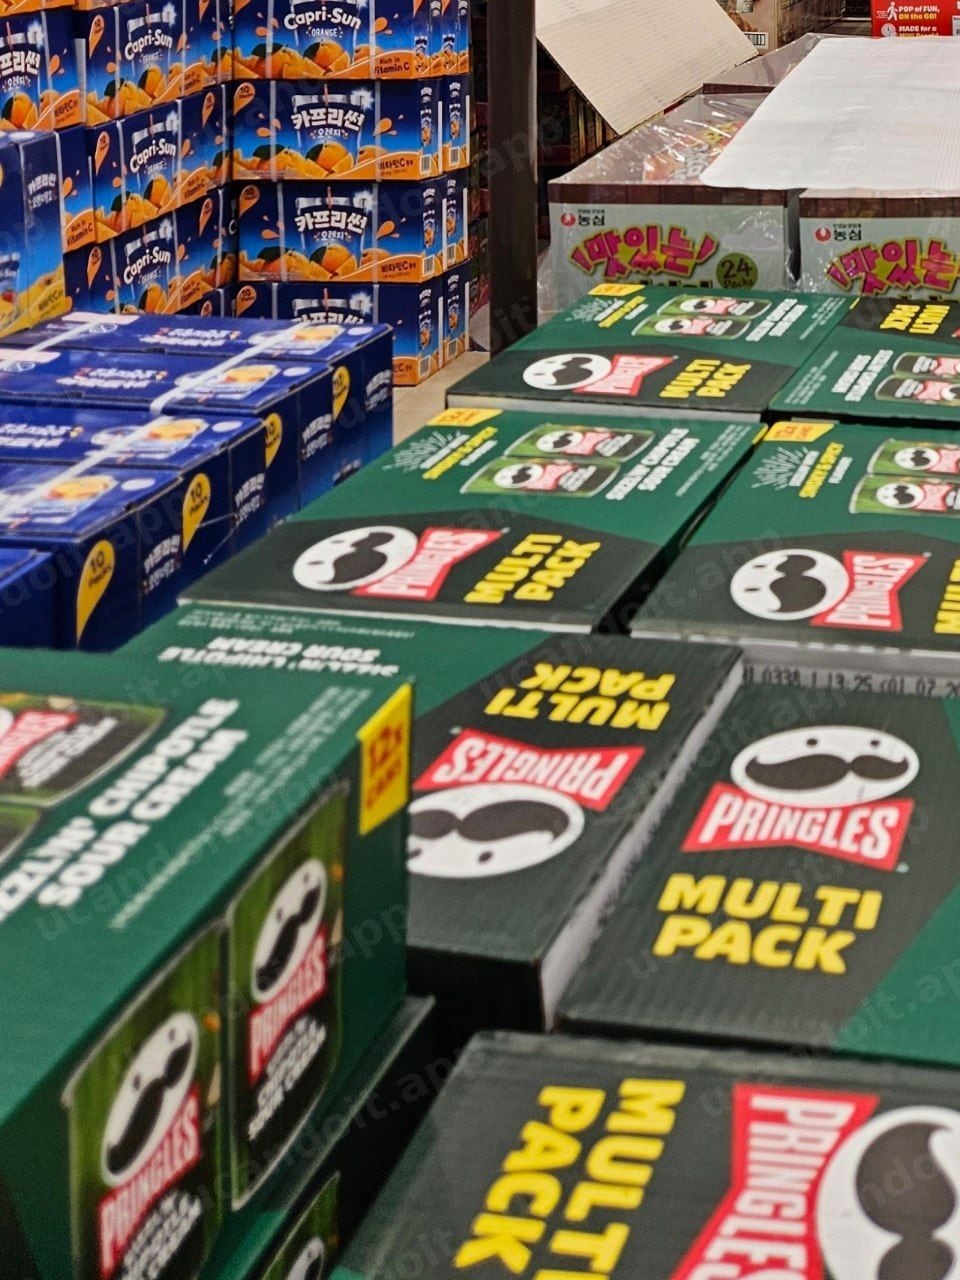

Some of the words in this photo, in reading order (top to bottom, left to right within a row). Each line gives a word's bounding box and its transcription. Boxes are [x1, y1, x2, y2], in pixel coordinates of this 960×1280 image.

[283, 6, 362, 30] Capri-Sun
[311, 28, 338, 38] ORANGE
[124, 28, 173, 61] Capri-Sun
[290, 107, 365, 132] 카프리썬
[316, 127, 342, 139] 오렌지
[130, 138, 177, 174] Capri-Sun
[294, 210, 368, 233] 카프리썬
[320, 231, 346, 241] 오렌지
[577, 215, 605, 226] 농심
[834, 229, 862, 241] 농심
[123, 246, 171, 285] Capri-Sun
[584, 226, 696, 278] 맛있는
[721, 257, 751, 280] 24
[841, 239, 957, 293] 맛있는
[463, 533, 563, 604] MULTI
[513, 539, 601, 601] PACK
[519, 662, 676, 700] PACK
[485, 689, 671, 730] MULTI
[433, 734, 629, 801] PRINGLES
[37, 820, 150, 907] SOUR
[131, 729, 248, 820] CREAM
[698, 792, 900, 860] PRINGLES
[657, 872, 883, 931] MULTI
[652, 915, 857, 975] PACK
[454, 1084, 606, 1275] PACK
